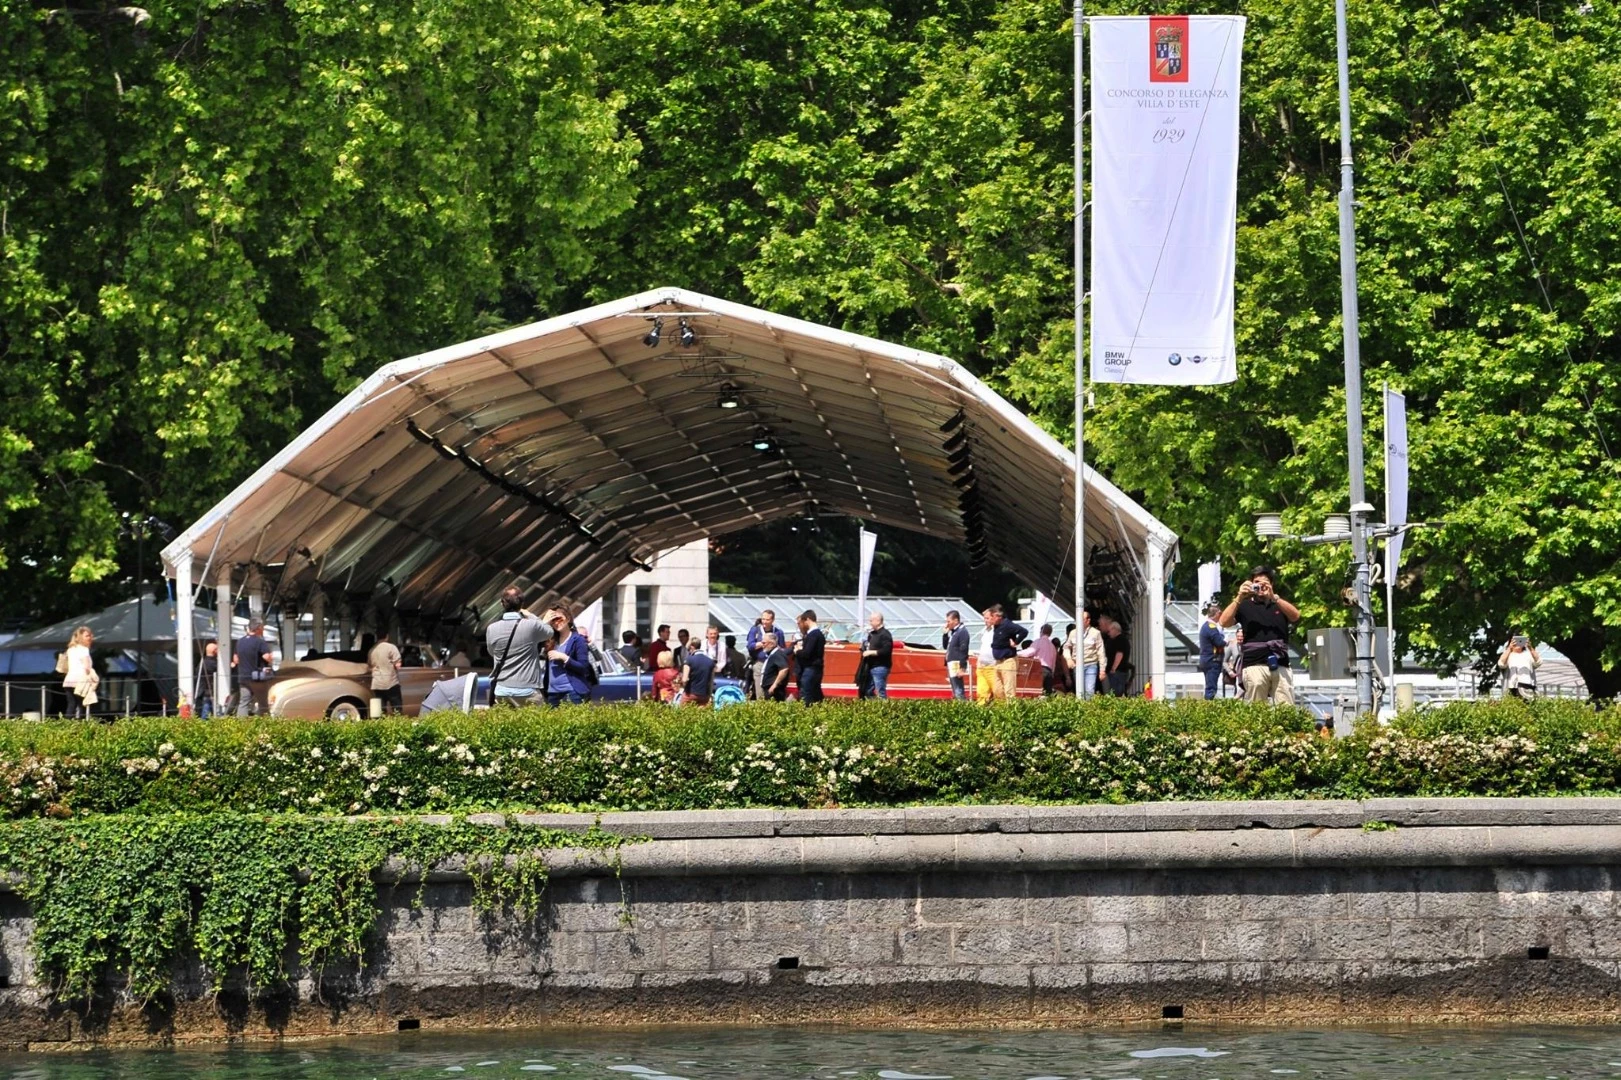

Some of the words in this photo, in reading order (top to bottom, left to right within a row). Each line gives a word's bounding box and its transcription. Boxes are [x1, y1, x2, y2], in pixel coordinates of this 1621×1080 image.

[1107, 88, 1164, 98] CONCORSO
[1167, 88, 1229, 98] D'ELEGANZA
[1138, 99, 1164, 108] VILLA
[1167, 99, 1200, 108] D'ESTE
[1152, 128, 1185, 144] 1929
[1104, 351, 1125, 359] BMW
